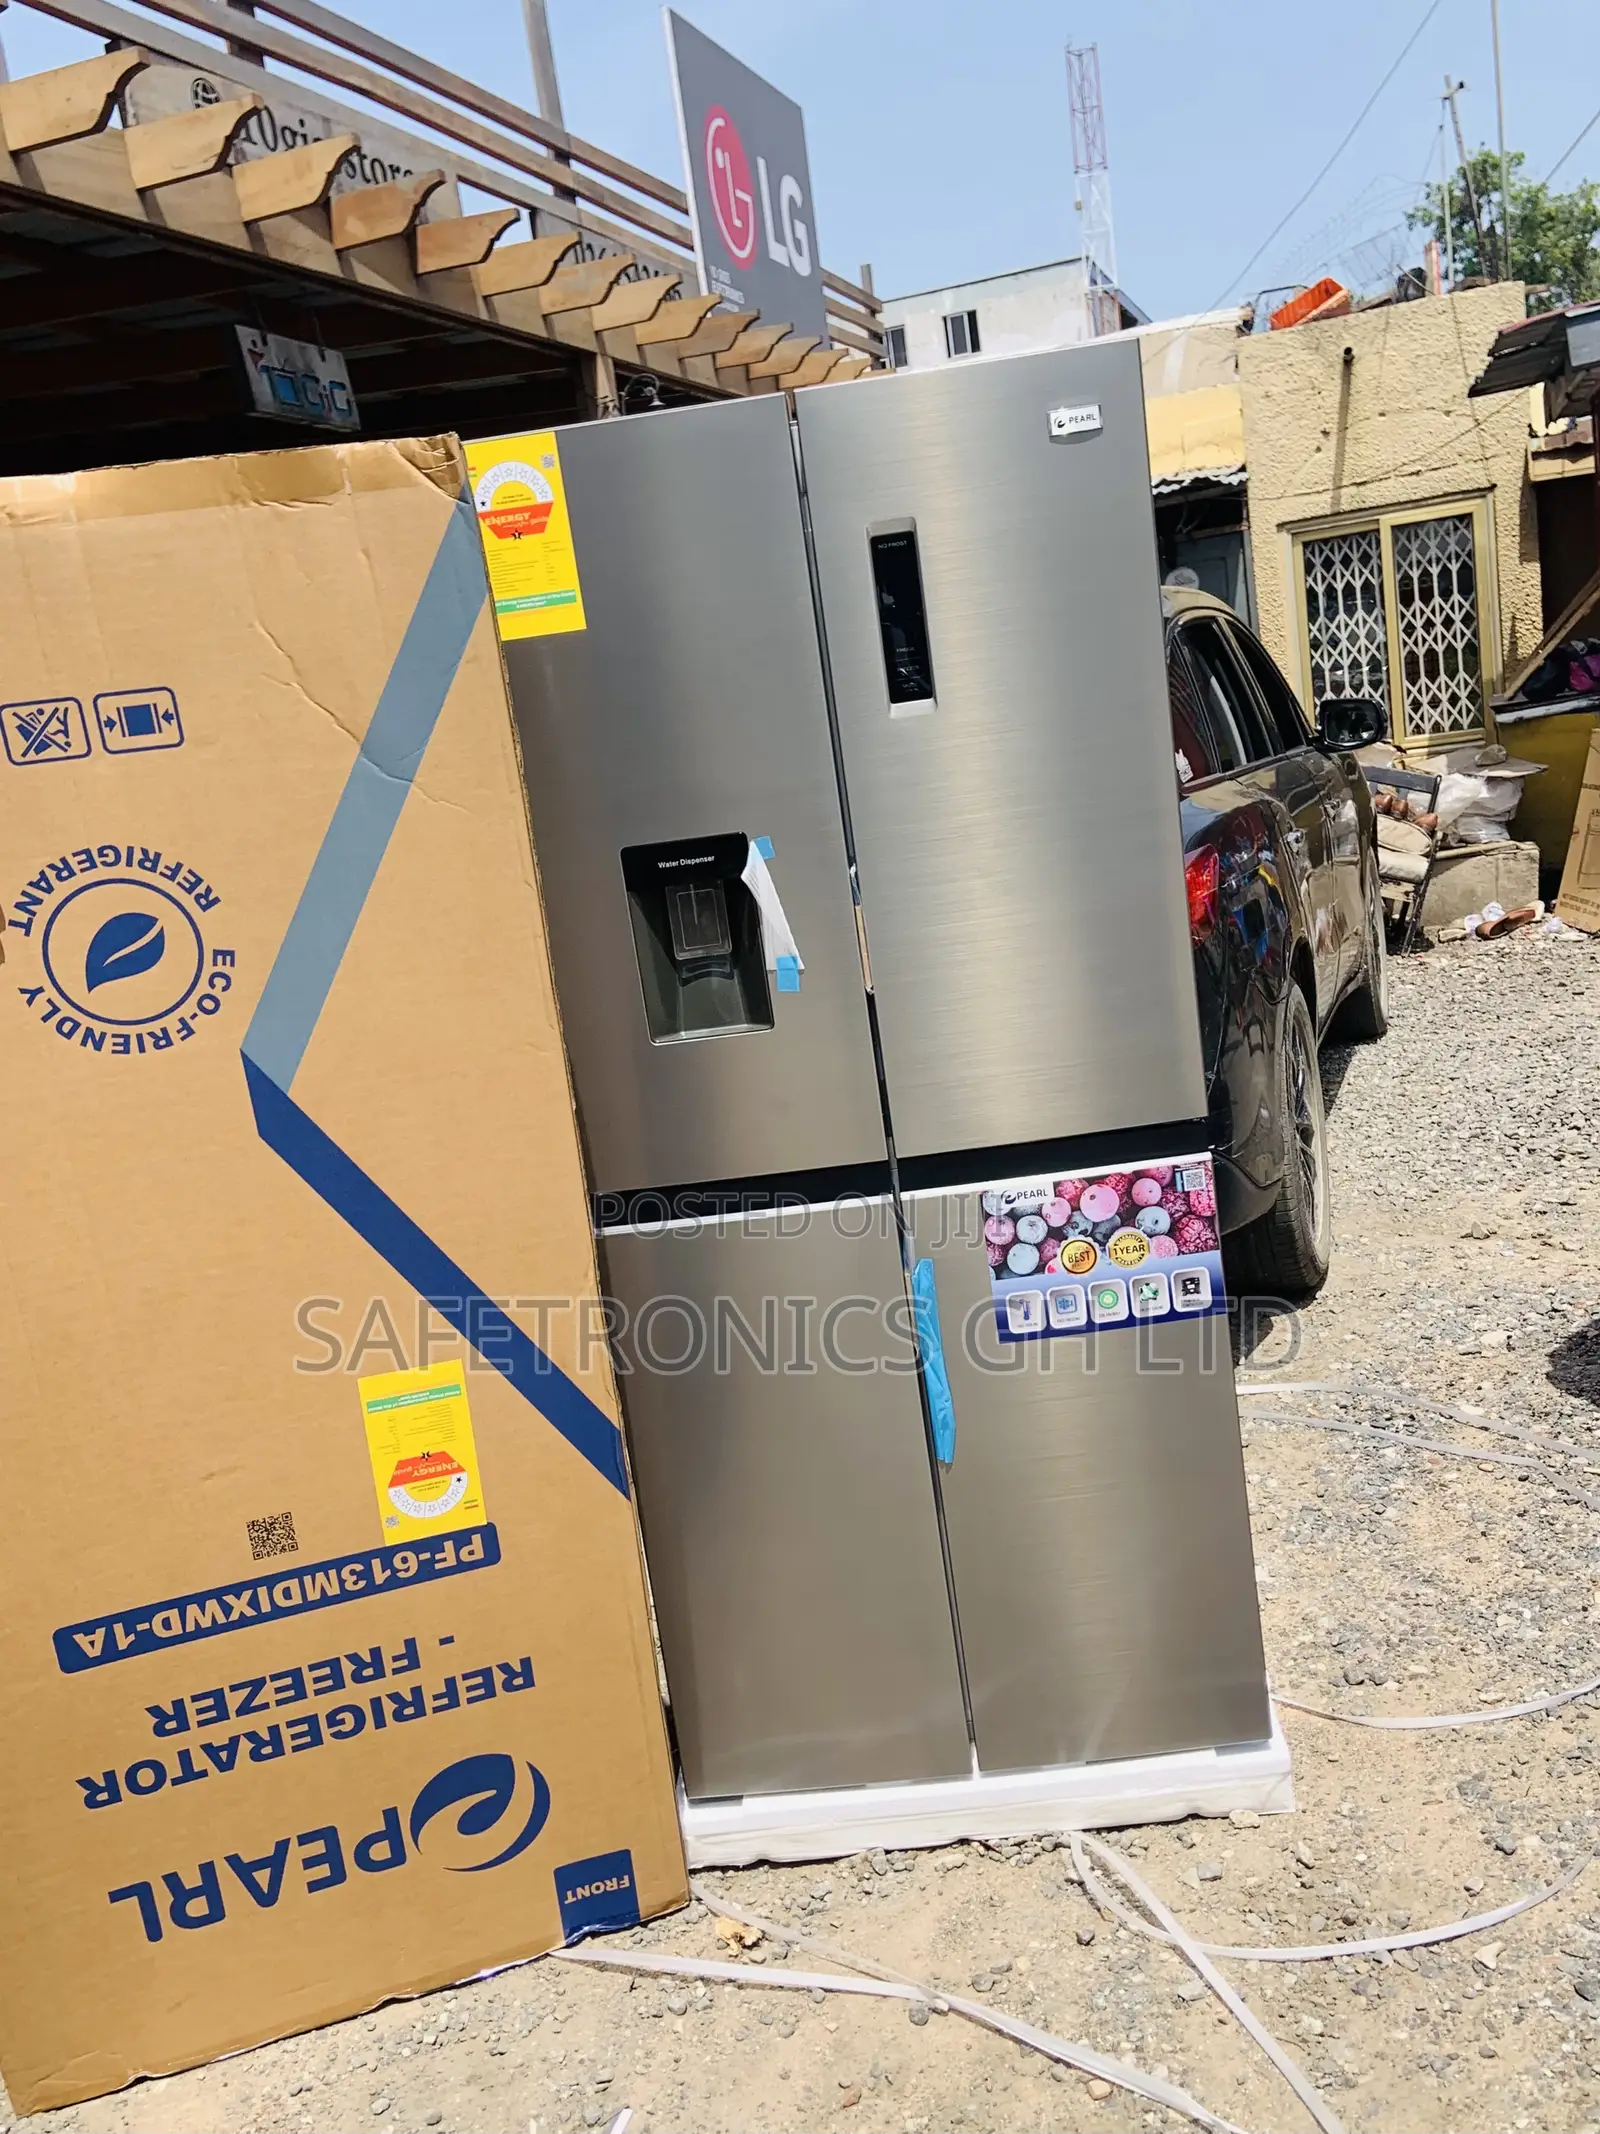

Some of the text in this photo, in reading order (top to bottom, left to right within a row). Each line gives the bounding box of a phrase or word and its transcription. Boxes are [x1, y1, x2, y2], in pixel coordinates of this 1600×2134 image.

[756, 155, 812, 277] LG
[1069, 413, 1097, 424] PEARL
[485, 512, 532, 527] ENERGY
[657, 855, 715, 868] Water Dispenser
[8, 844, 222, 937] REFRIGERANT
[17, 948, 236, 1055] ECO-FRIENDLY
[1016, 1189, 1048, 1200] PEARL
[1067, 1250, 1091, 1264] BEST
[1119, 1244, 1146, 1255] YEAR
[413, 1461, 460, 1477] ENERGY
[73, 1533, 486, 1659] PF-613MDIXWD-1A
[144, 1636, 422, 1738] FREEZER
[75, 1656, 536, 1810] REFRIGERATOR
[107, 1805, 408, 1943] PEARL
[564, 1874, 631, 1905] FRONT
